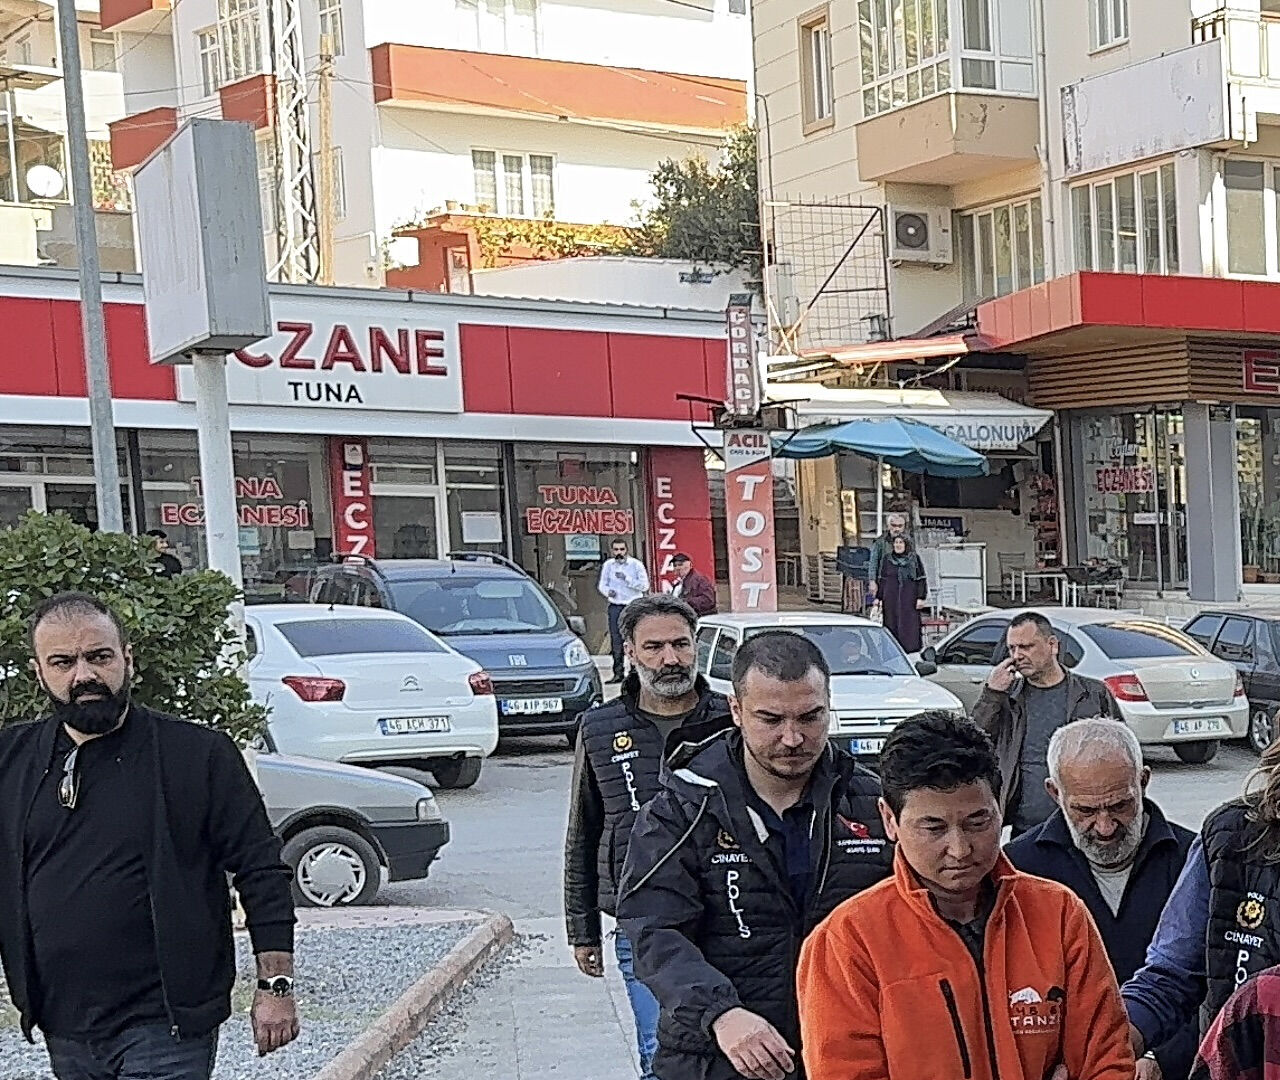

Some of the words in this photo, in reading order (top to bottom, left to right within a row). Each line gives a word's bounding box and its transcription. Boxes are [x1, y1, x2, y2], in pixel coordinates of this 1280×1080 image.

[288, 381, 363, 403] TUNA
[190, 476, 283, 499] TNA
[538, 485, 618, 504] TUNA
[736, 474, 771, 608] TOST
